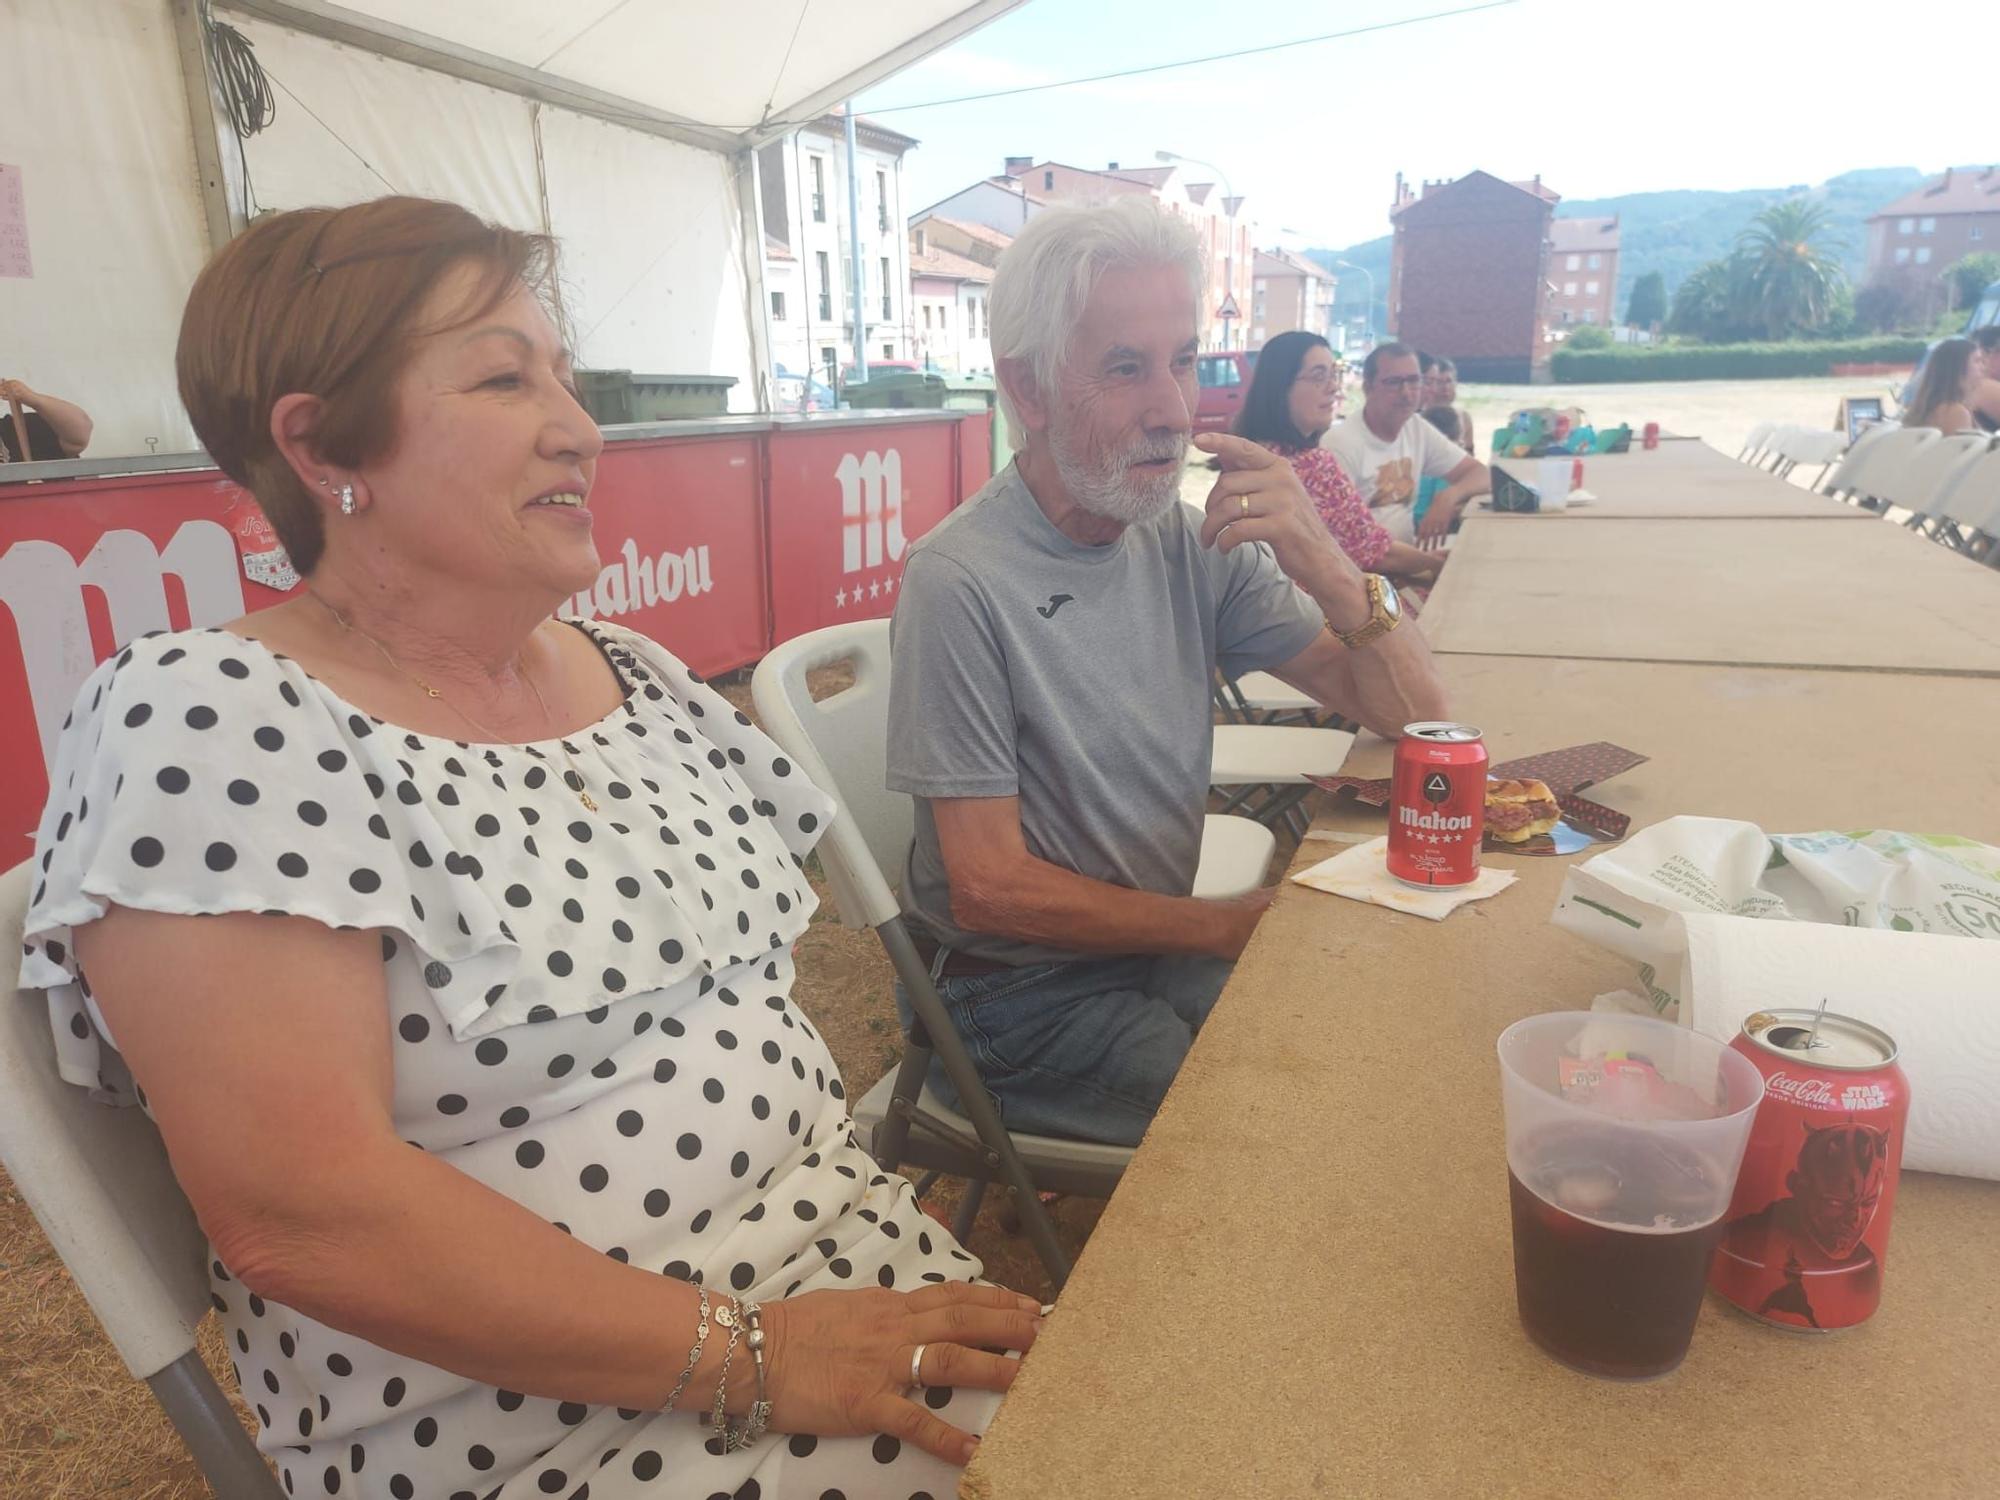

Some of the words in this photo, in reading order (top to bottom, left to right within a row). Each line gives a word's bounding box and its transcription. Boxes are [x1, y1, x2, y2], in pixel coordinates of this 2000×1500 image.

[1399, 805, 1472, 831] Mahou
[1765, 1071, 1834, 1105] Coca-Cola
[1846, 1086, 1880, 1099] STAR
[1842, 1096, 1888, 1111] WARS
